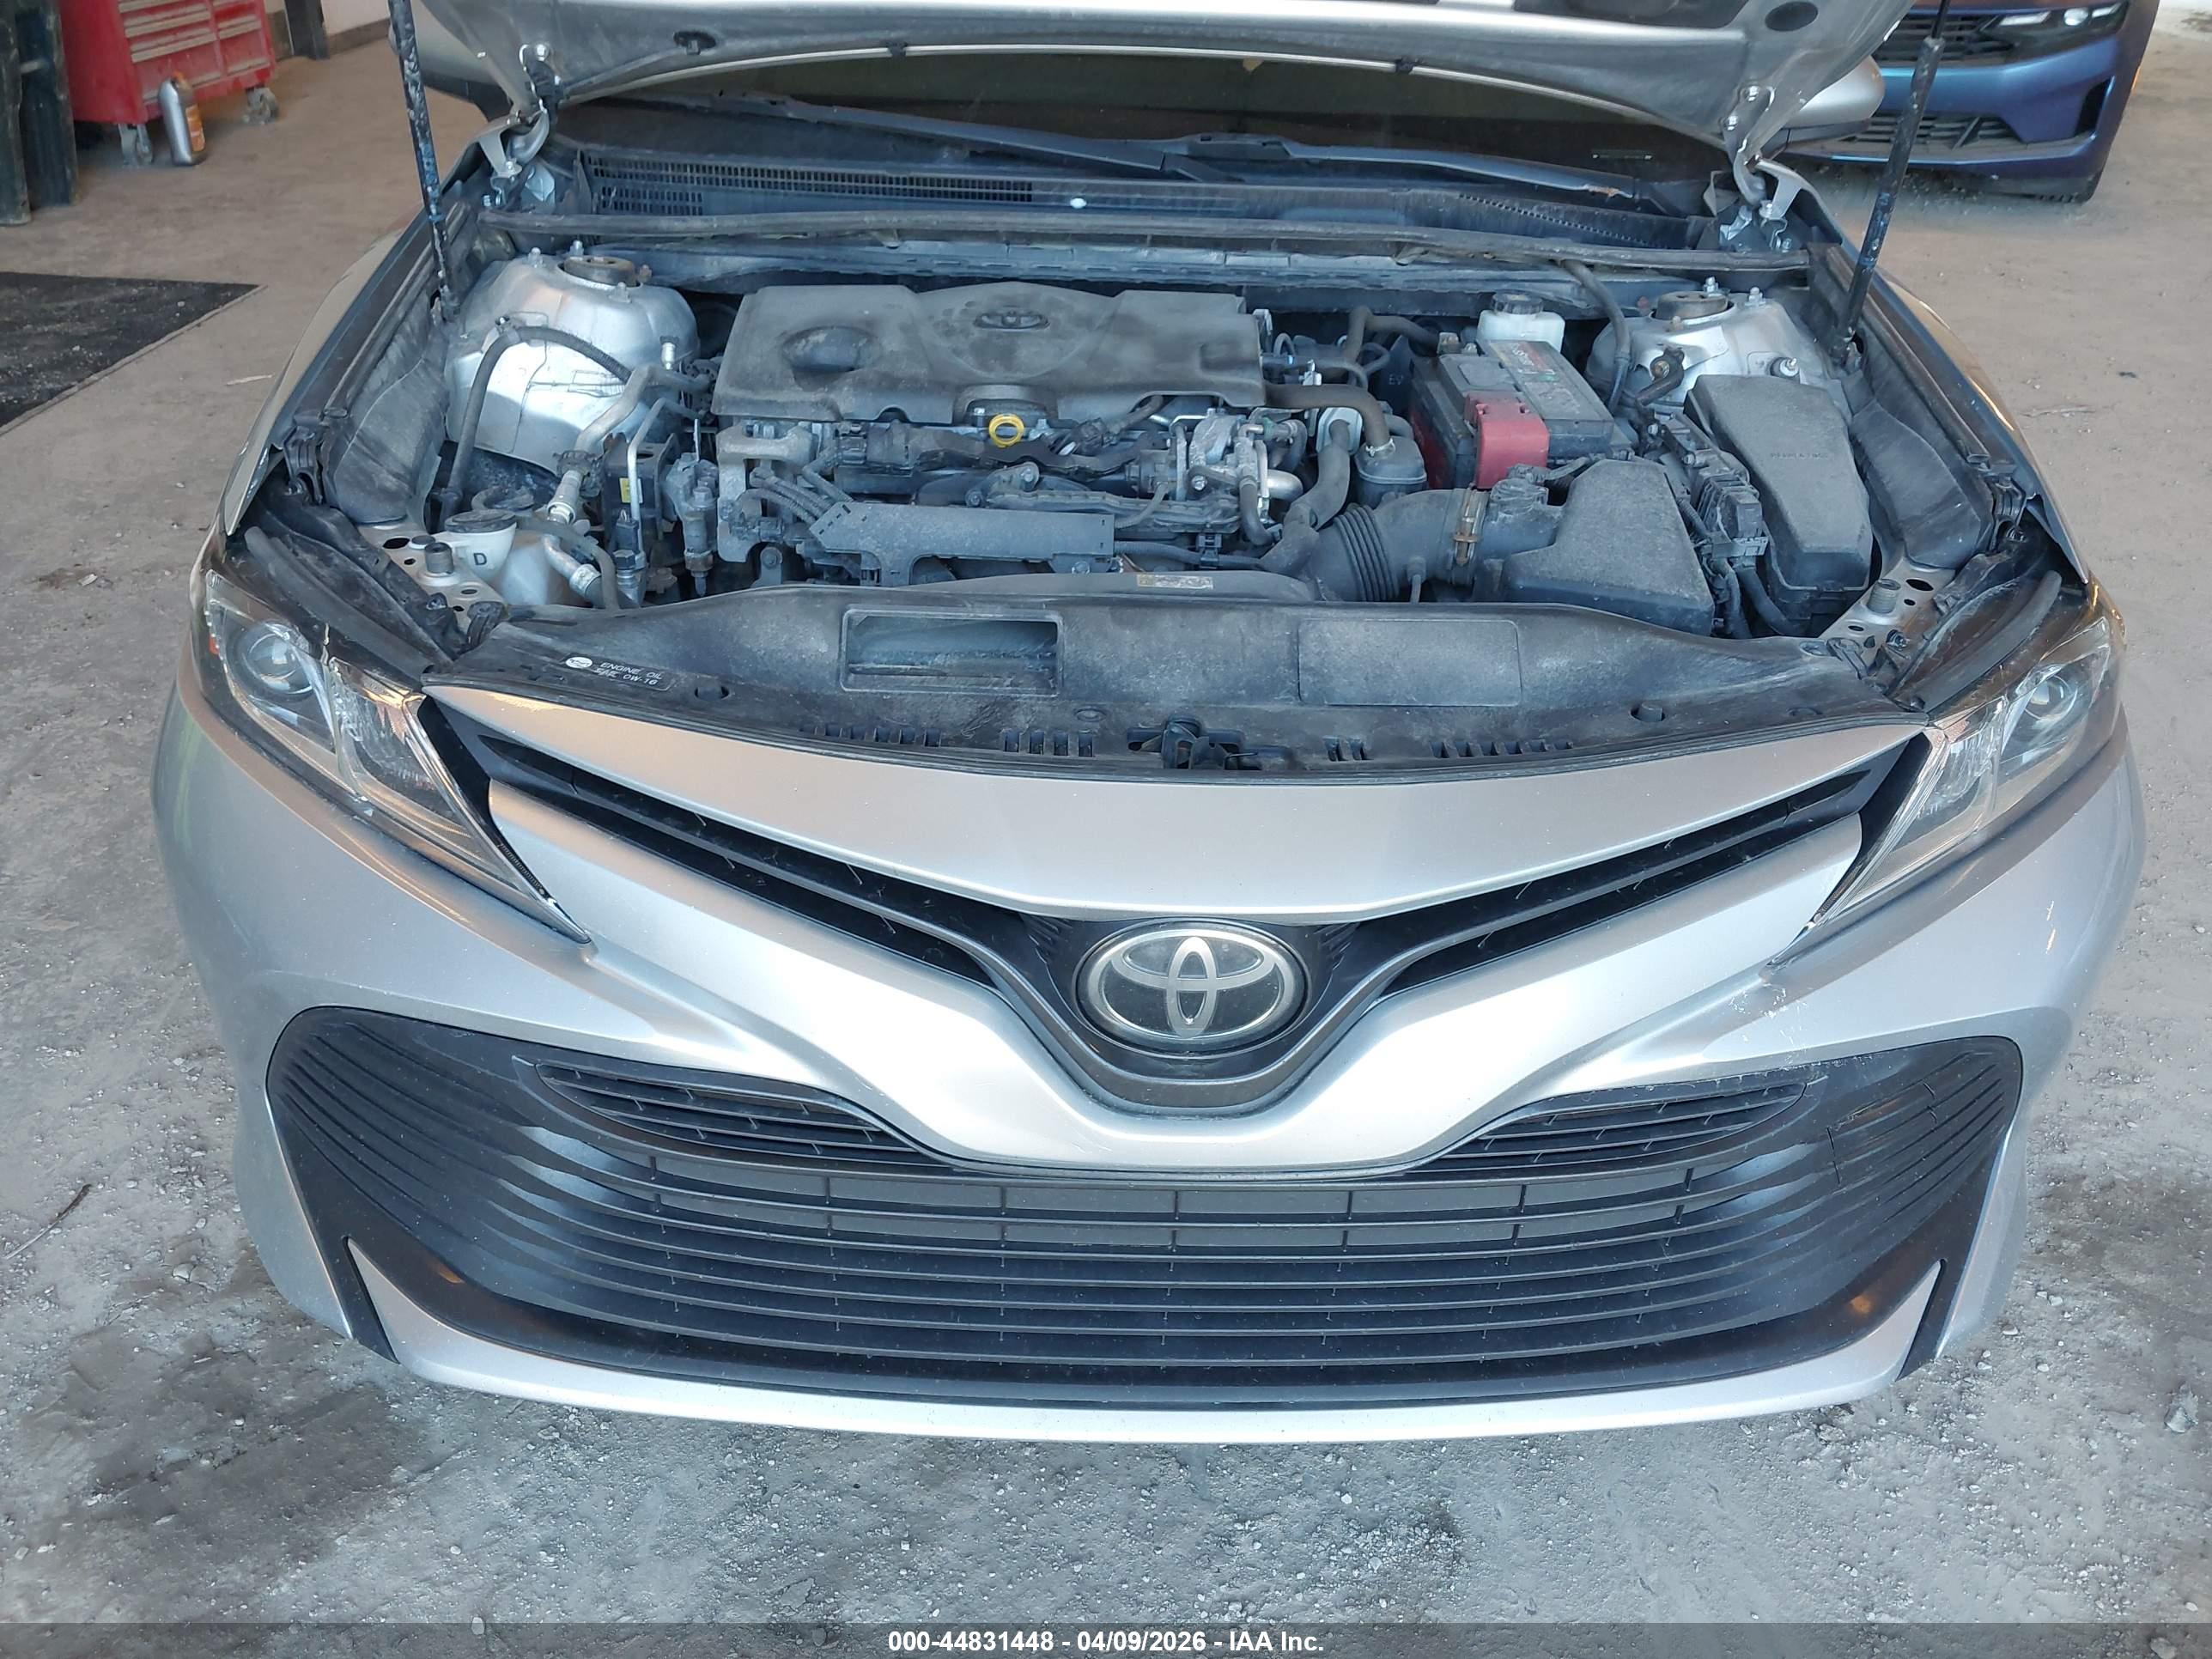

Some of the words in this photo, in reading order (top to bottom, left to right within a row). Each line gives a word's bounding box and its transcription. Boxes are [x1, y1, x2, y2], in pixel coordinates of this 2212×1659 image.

[473, 552, 488, 566] D
[592, 667, 619, 678] SAE
[599, 661, 642, 675] ENGINE
[646, 671, 663, 680] OIL
